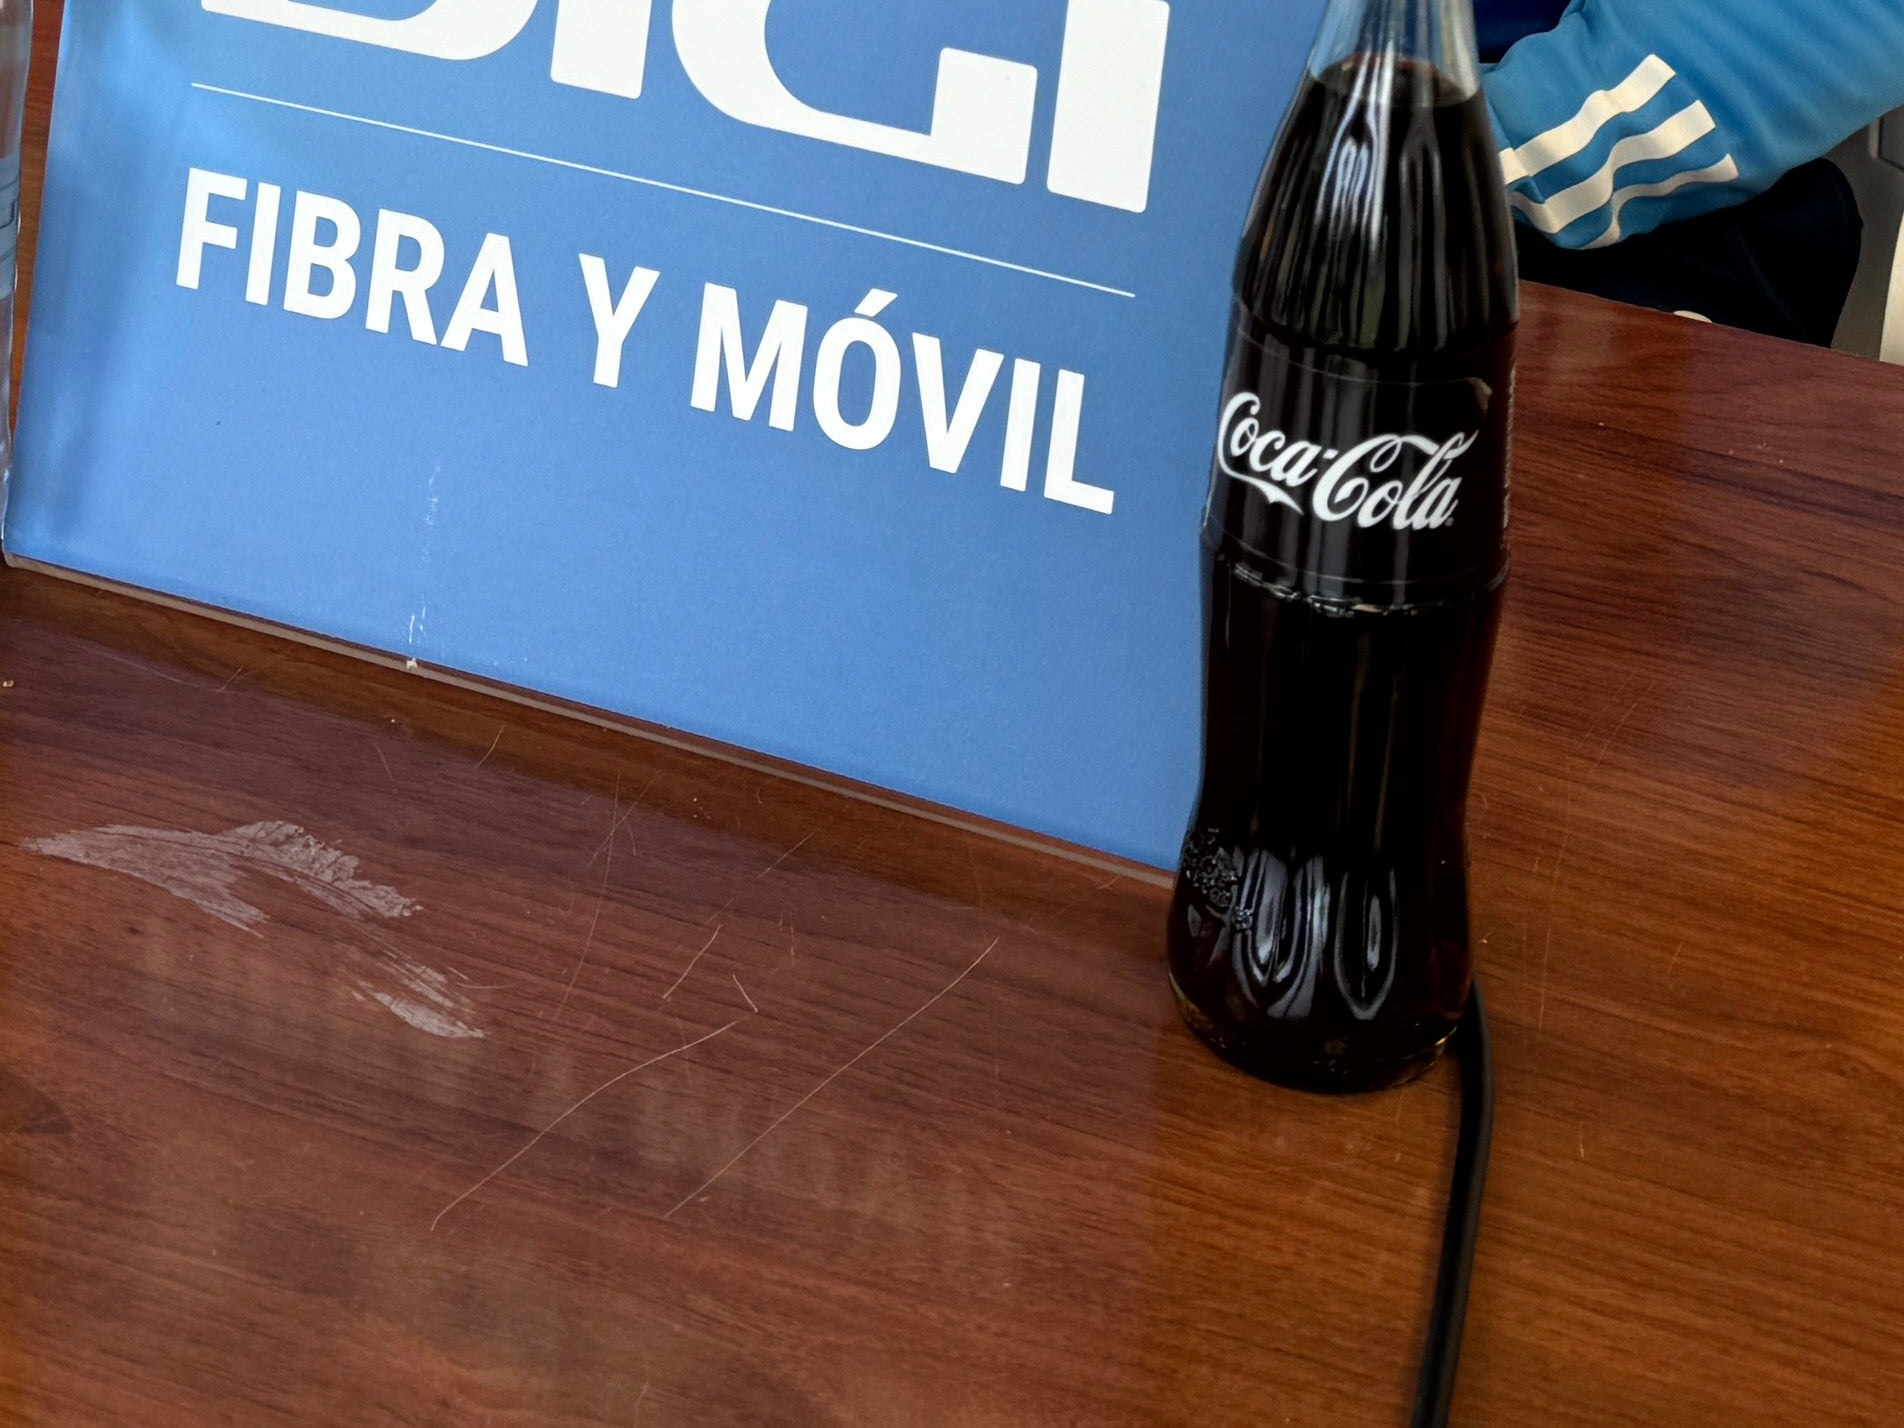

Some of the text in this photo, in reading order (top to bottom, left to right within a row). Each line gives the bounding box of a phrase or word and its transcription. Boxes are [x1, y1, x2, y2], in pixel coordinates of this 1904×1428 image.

[175, 166, 1116, 515] FIBRA Y MÓVIL
[1216, 391, 1478, 532] Coca-Cola
